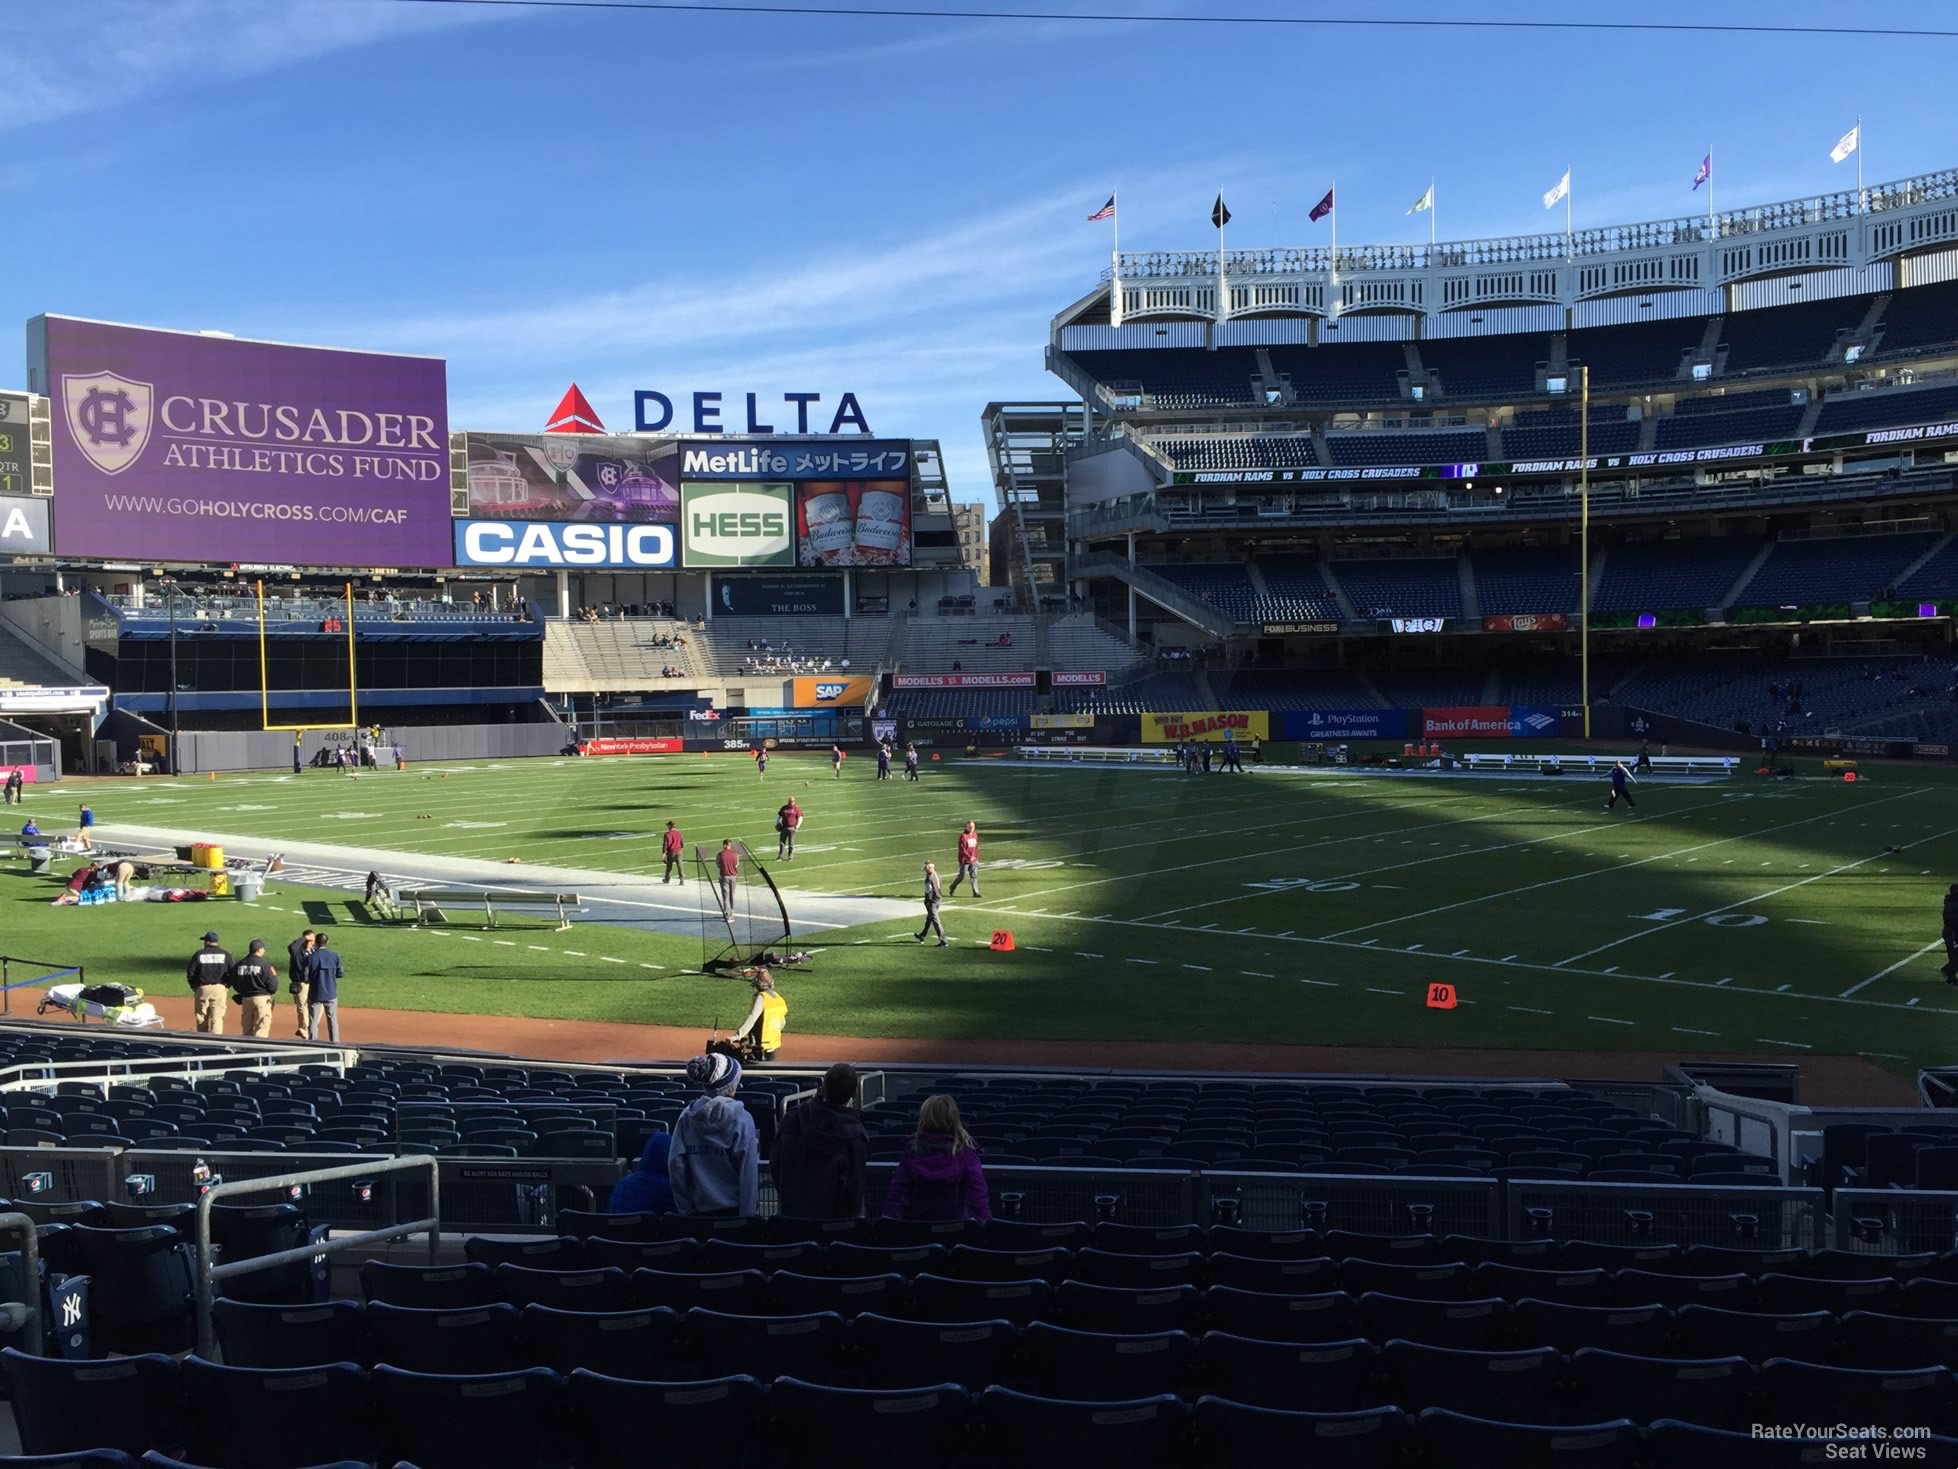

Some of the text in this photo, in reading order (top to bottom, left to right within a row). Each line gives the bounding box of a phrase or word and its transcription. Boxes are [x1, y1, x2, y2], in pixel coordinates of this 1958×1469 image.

[634, 389, 870, 433] DELTA
[161, 395, 440, 449] CRUSADER
[1866, 427, 1924, 444] FORDHAM
[163, 443, 441, 482] ATHLETICS FUND
[683, 448, 906, 473] MetLife メットライフ
[1511, 461, 1564, 473] FORDHAM
[1628, 454, 1657, 466] HOLY
[1658, 452, 1695, 464] CROSS
[1697, 445, 1763, 461] CRUSADERS
[1194, 472, 1242, 483] FORDHAM
[1244, 471, 1274, 482] RAMS
[1301, 469, 1327, 480] HOLY
[1327, 468, 1360, 479] CROSS
[1361, 467, 1421, 478] CRUSADERS
[104, 493, 407, 525] WWW.GOHOLYCROSS.COM/CAF
[693, 512, 784, 537] HESS
[465, 522, 675, 565] CASIO
[771, 604, 817, 612] THE BOSS
[1285, 624, 1338, 633] BUSINESS
[898, 675, 1031, 685] MODELL'S MODELLS.com
[1057, 673, 1101, 683] MODELL'S
[816, 685, 843, 699] SAP
[690, 710, 720, 720] FedEx
[1328, 714, 1379, 724] PlayStation
[992, 717, 1018, 728] pepsi
[1426, 719, 1521, 731] Bank of America
[1310, 729, 1378, 738] GREATNESS AWAITS
[993, 932, 1007, 945] 20
[1432, 987, 1449, 1002] 10
